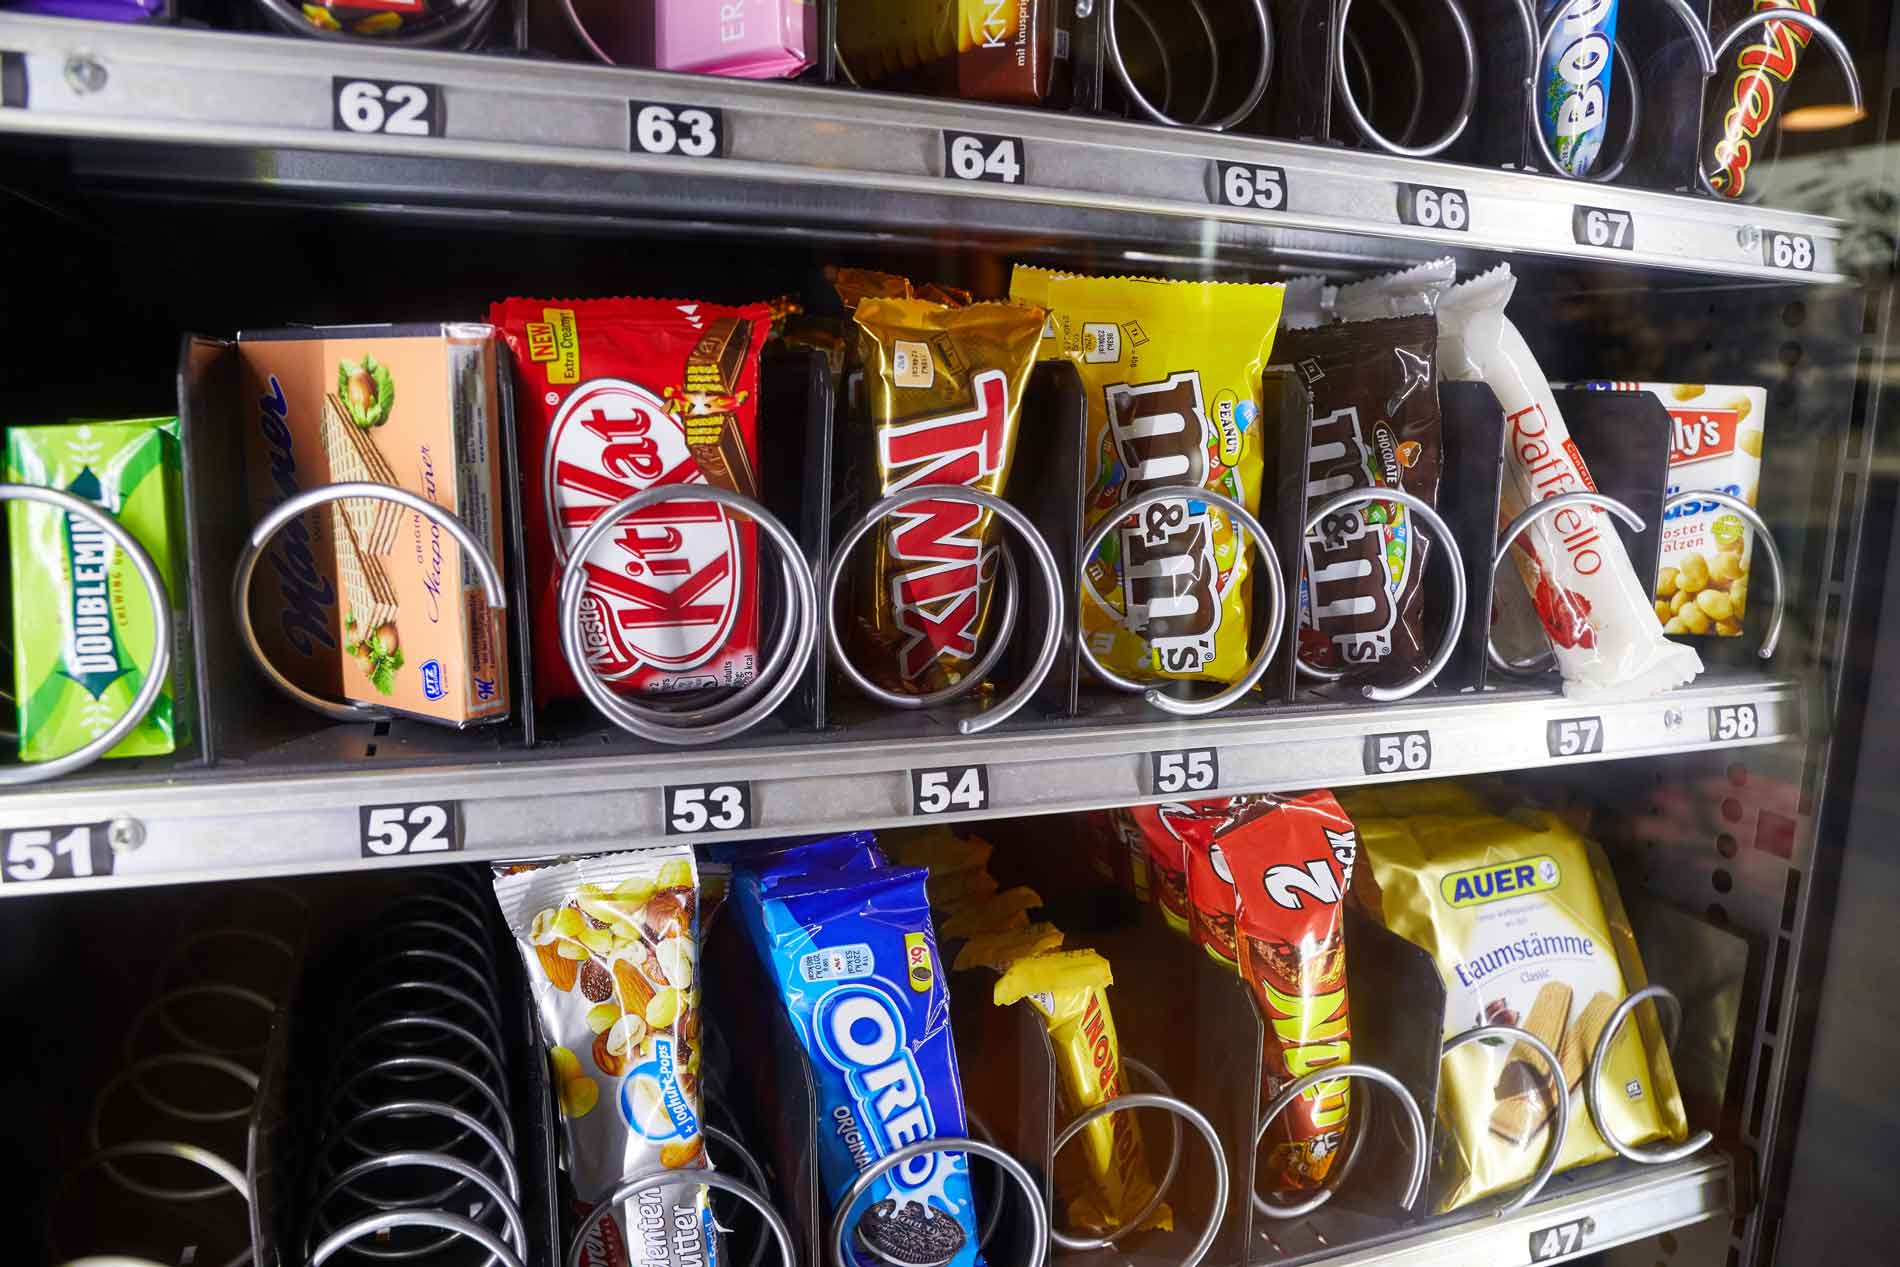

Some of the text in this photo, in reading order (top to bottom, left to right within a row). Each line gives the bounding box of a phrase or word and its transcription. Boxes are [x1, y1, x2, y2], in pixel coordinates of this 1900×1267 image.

[1015, 48, 1026, 66] mit
[339, 81, 430, 136] 62
[636, 107, 717, 156] 63
[951, 136, 1020, 183] 64
[1224, 166, 1283, 209] 65
[1415, 189, 1467, 229] 66
[1586, 211, 1631, 247] 67
[1772, 234, 1813, 268] 68
[530, 325, 555, 358] NEW
[563, 352, 575, 379] Extra
[1219, 401, 1239, 456] PEANUT
[1375, 428, 1398, 485] CHOCOLATE
[413, 513, 425, 565] ORIGIN
[558, 407, 731, 630] Kit Kat
[1104, 371, 1222, 673] m&m's
[67, 507, 119, 675] DOUBLEMIN
[425, 667, 436, 696] UTZ
[744, 654, 753, 670] kcal
[1559, 720, 1600, 755] 57
[1718, 706, 1756, 739] 58
[1158, 752, 1214, 793] 55
[1378, 735, 1427, 772] 56
[671, 786, 745, 832] 53
[918, 768, 985, 813] 54
[367, 806, 450, 855] 52
[5, 831, 95, 881] 51
[1264, 860, 1342, 909] 2
[1454, 864, 1536, 903] AUER
[807, 966, 816, 981] kcal
[846, 960, 856, 974] kcal
[910, 945, 928, 966] 6x
[832, 995, 938, 1192] OREO
[1539, 1226, 1580, 1259] 47
